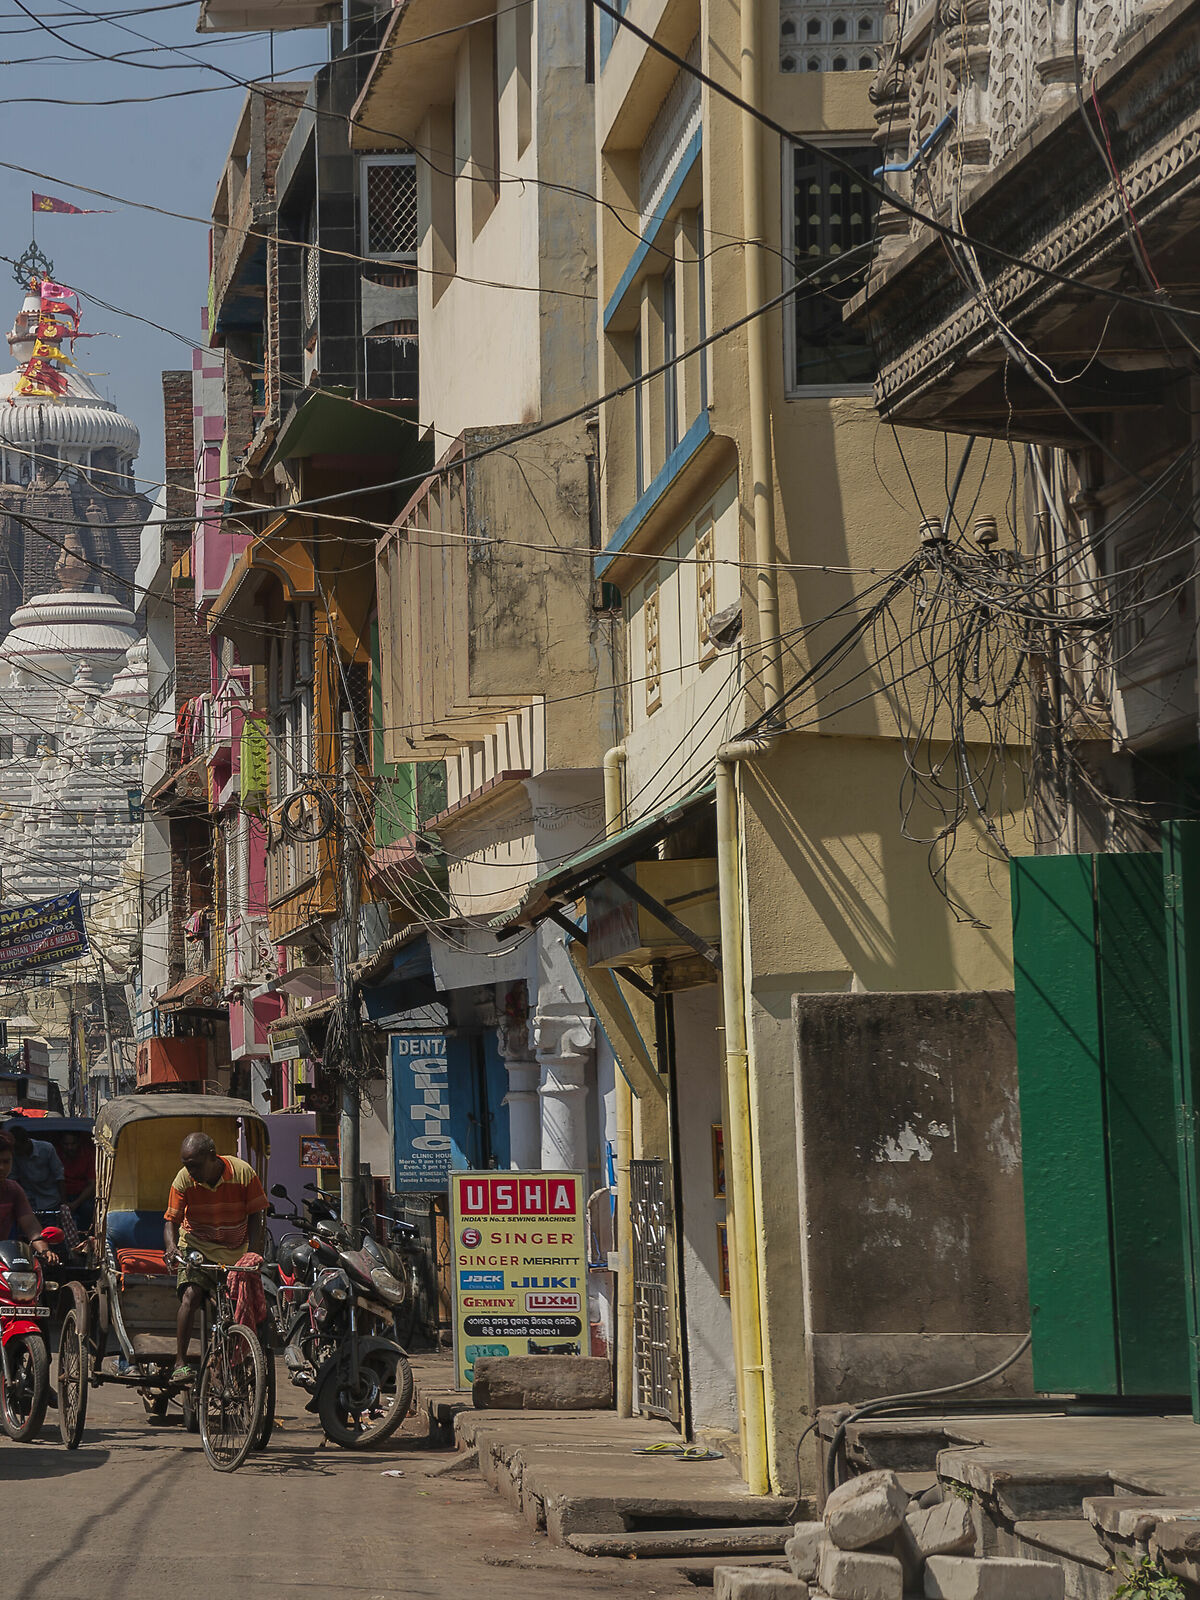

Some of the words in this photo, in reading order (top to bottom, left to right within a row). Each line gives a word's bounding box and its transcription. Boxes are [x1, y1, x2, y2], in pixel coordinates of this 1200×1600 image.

[6, 947, 29, 958] INDIAN
[56, 932, 76, 944] MEALS
[26, 943, 84, 964] भोजनालय
[409, 1057, 451, 1151] CLINIC
[466, 1184, 571, 1210] USHA
[490, 1232, 574, 1244] SINGER
[459, 1255, 519, 1266] SINGER
[522, 1257, 580, 1265] MERRITT
[511, 1276, 577, 1288] JUKI
[463, 1297, 515, 1307] GEMINY
[529, 1296, 577, 1309] LUXMI
